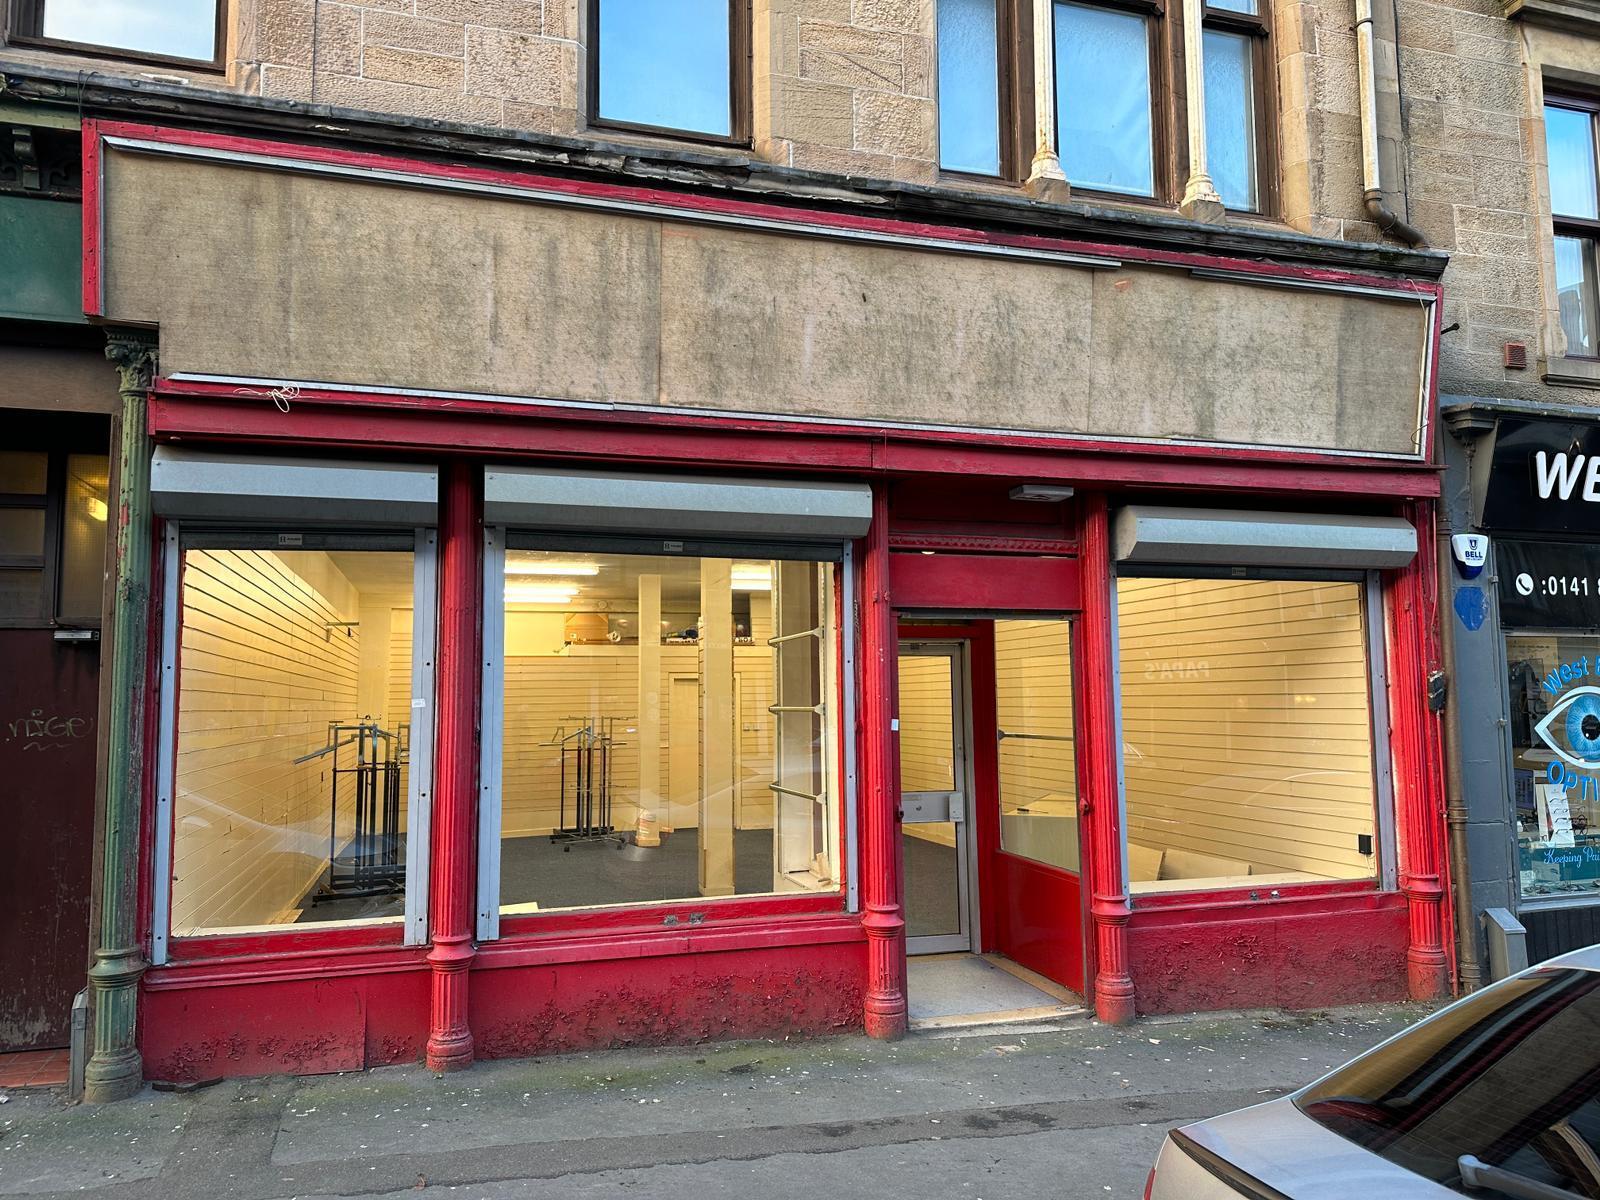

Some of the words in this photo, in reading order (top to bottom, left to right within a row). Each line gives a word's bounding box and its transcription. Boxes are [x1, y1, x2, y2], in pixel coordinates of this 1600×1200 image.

[1535, 450, 1600, 502] WE
[1542, 655, 1590, 696] West
[1543, 849, 1582, 868] Keeping
